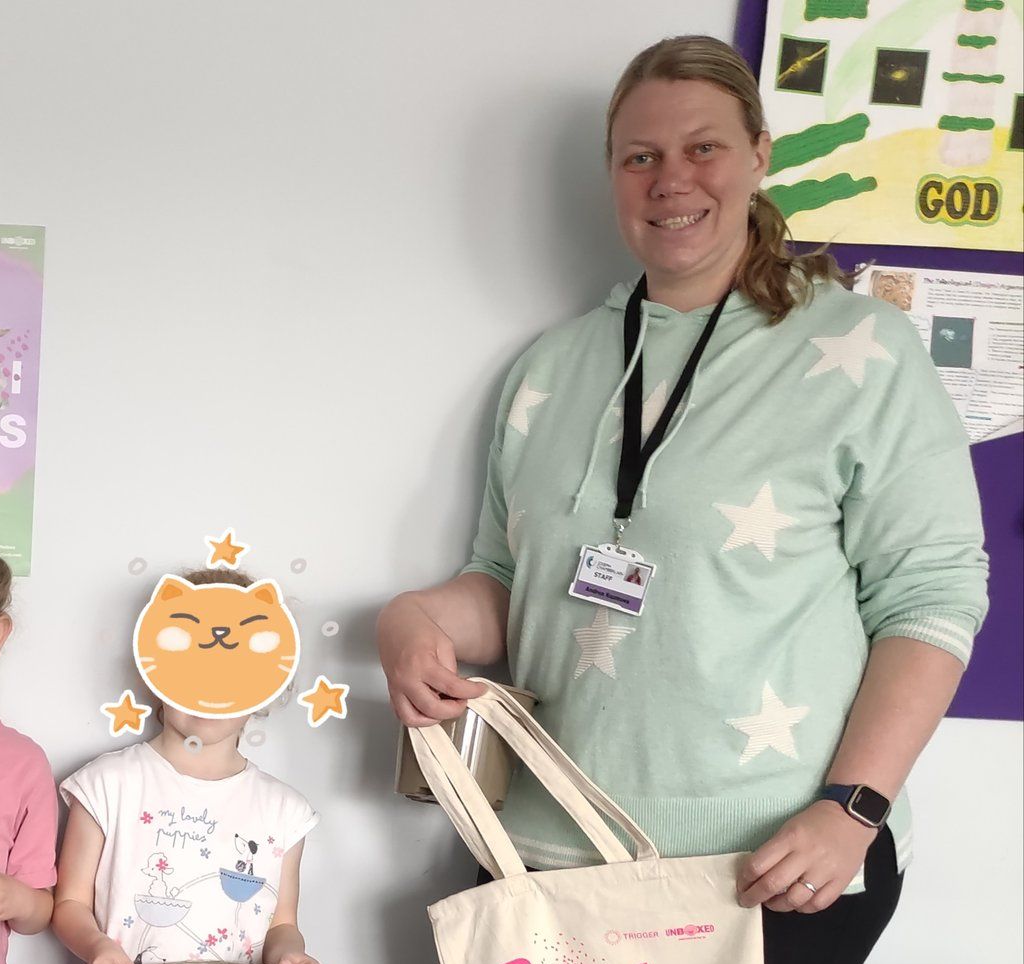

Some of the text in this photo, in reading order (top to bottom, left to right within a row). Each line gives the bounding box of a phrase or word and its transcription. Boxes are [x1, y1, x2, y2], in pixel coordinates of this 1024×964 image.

[919, 181, 999, 221] GOD
[593, 571, 613, 581] STAFF
[158, 806, 219, 834] my lovely
[155, 828, 207, 849] puppies
[623, 931, 660, 940] TRIGGER
